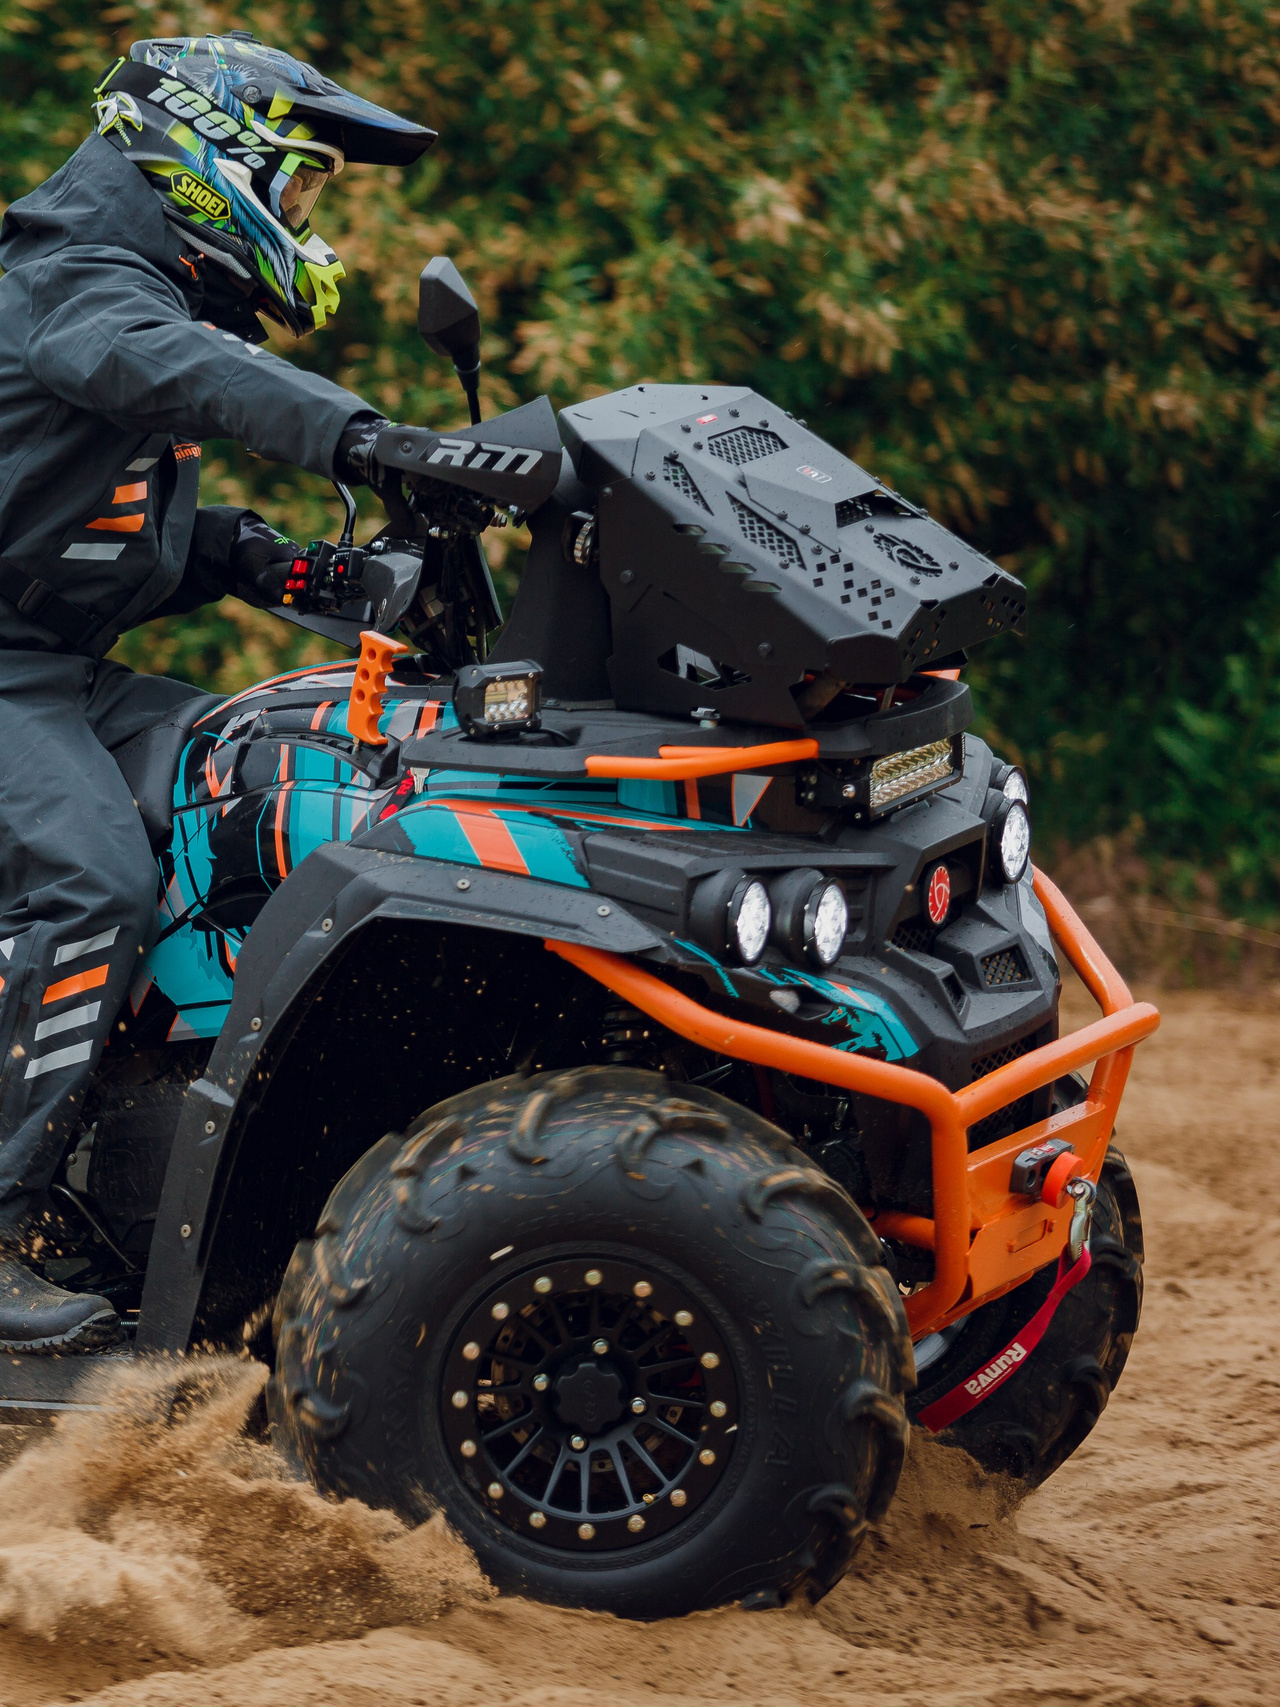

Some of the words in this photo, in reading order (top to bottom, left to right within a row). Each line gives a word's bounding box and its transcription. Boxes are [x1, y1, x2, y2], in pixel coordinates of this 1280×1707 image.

[147, 77, 276, 169] 100%
[176, 174, 226, 217] SHOEI
[964, 1342, 1027, 1395] Runva
